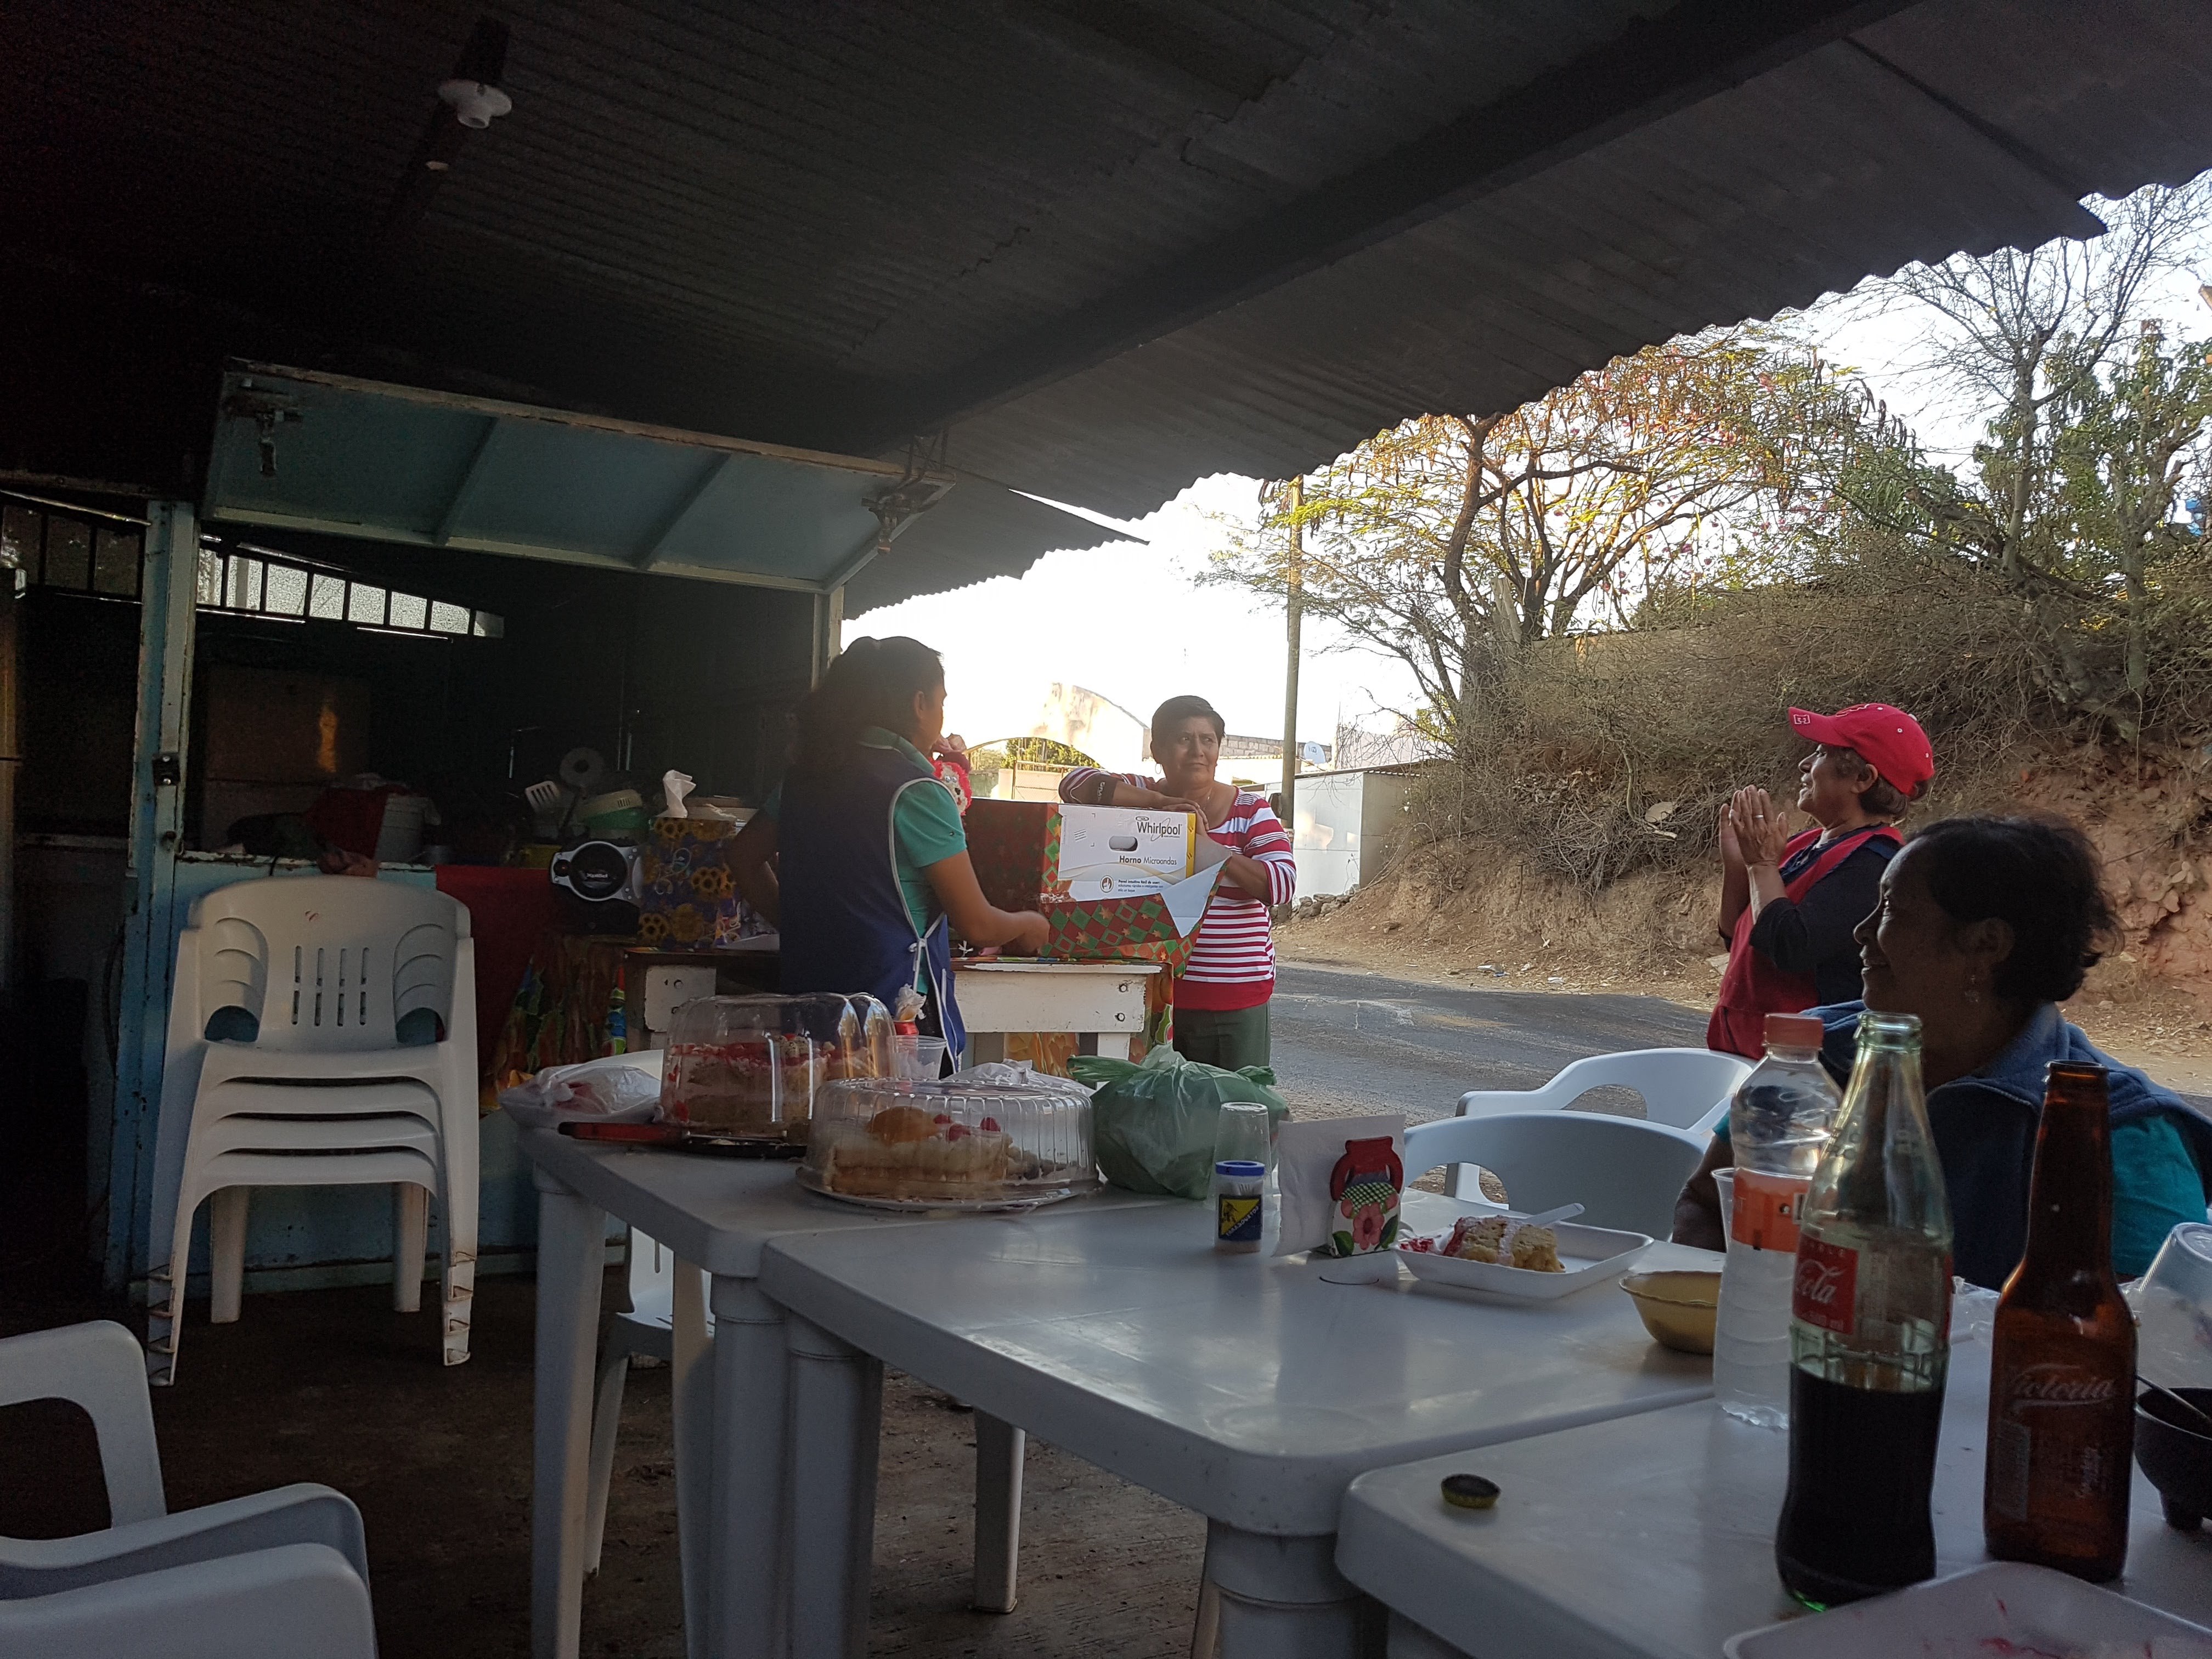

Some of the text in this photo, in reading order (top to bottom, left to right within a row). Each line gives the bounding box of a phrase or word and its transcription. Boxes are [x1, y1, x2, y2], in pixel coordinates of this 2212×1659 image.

[1137, 821, 1180, 838] Whirlpool
[1119, 855, 1177, 865] Horno Microondas
